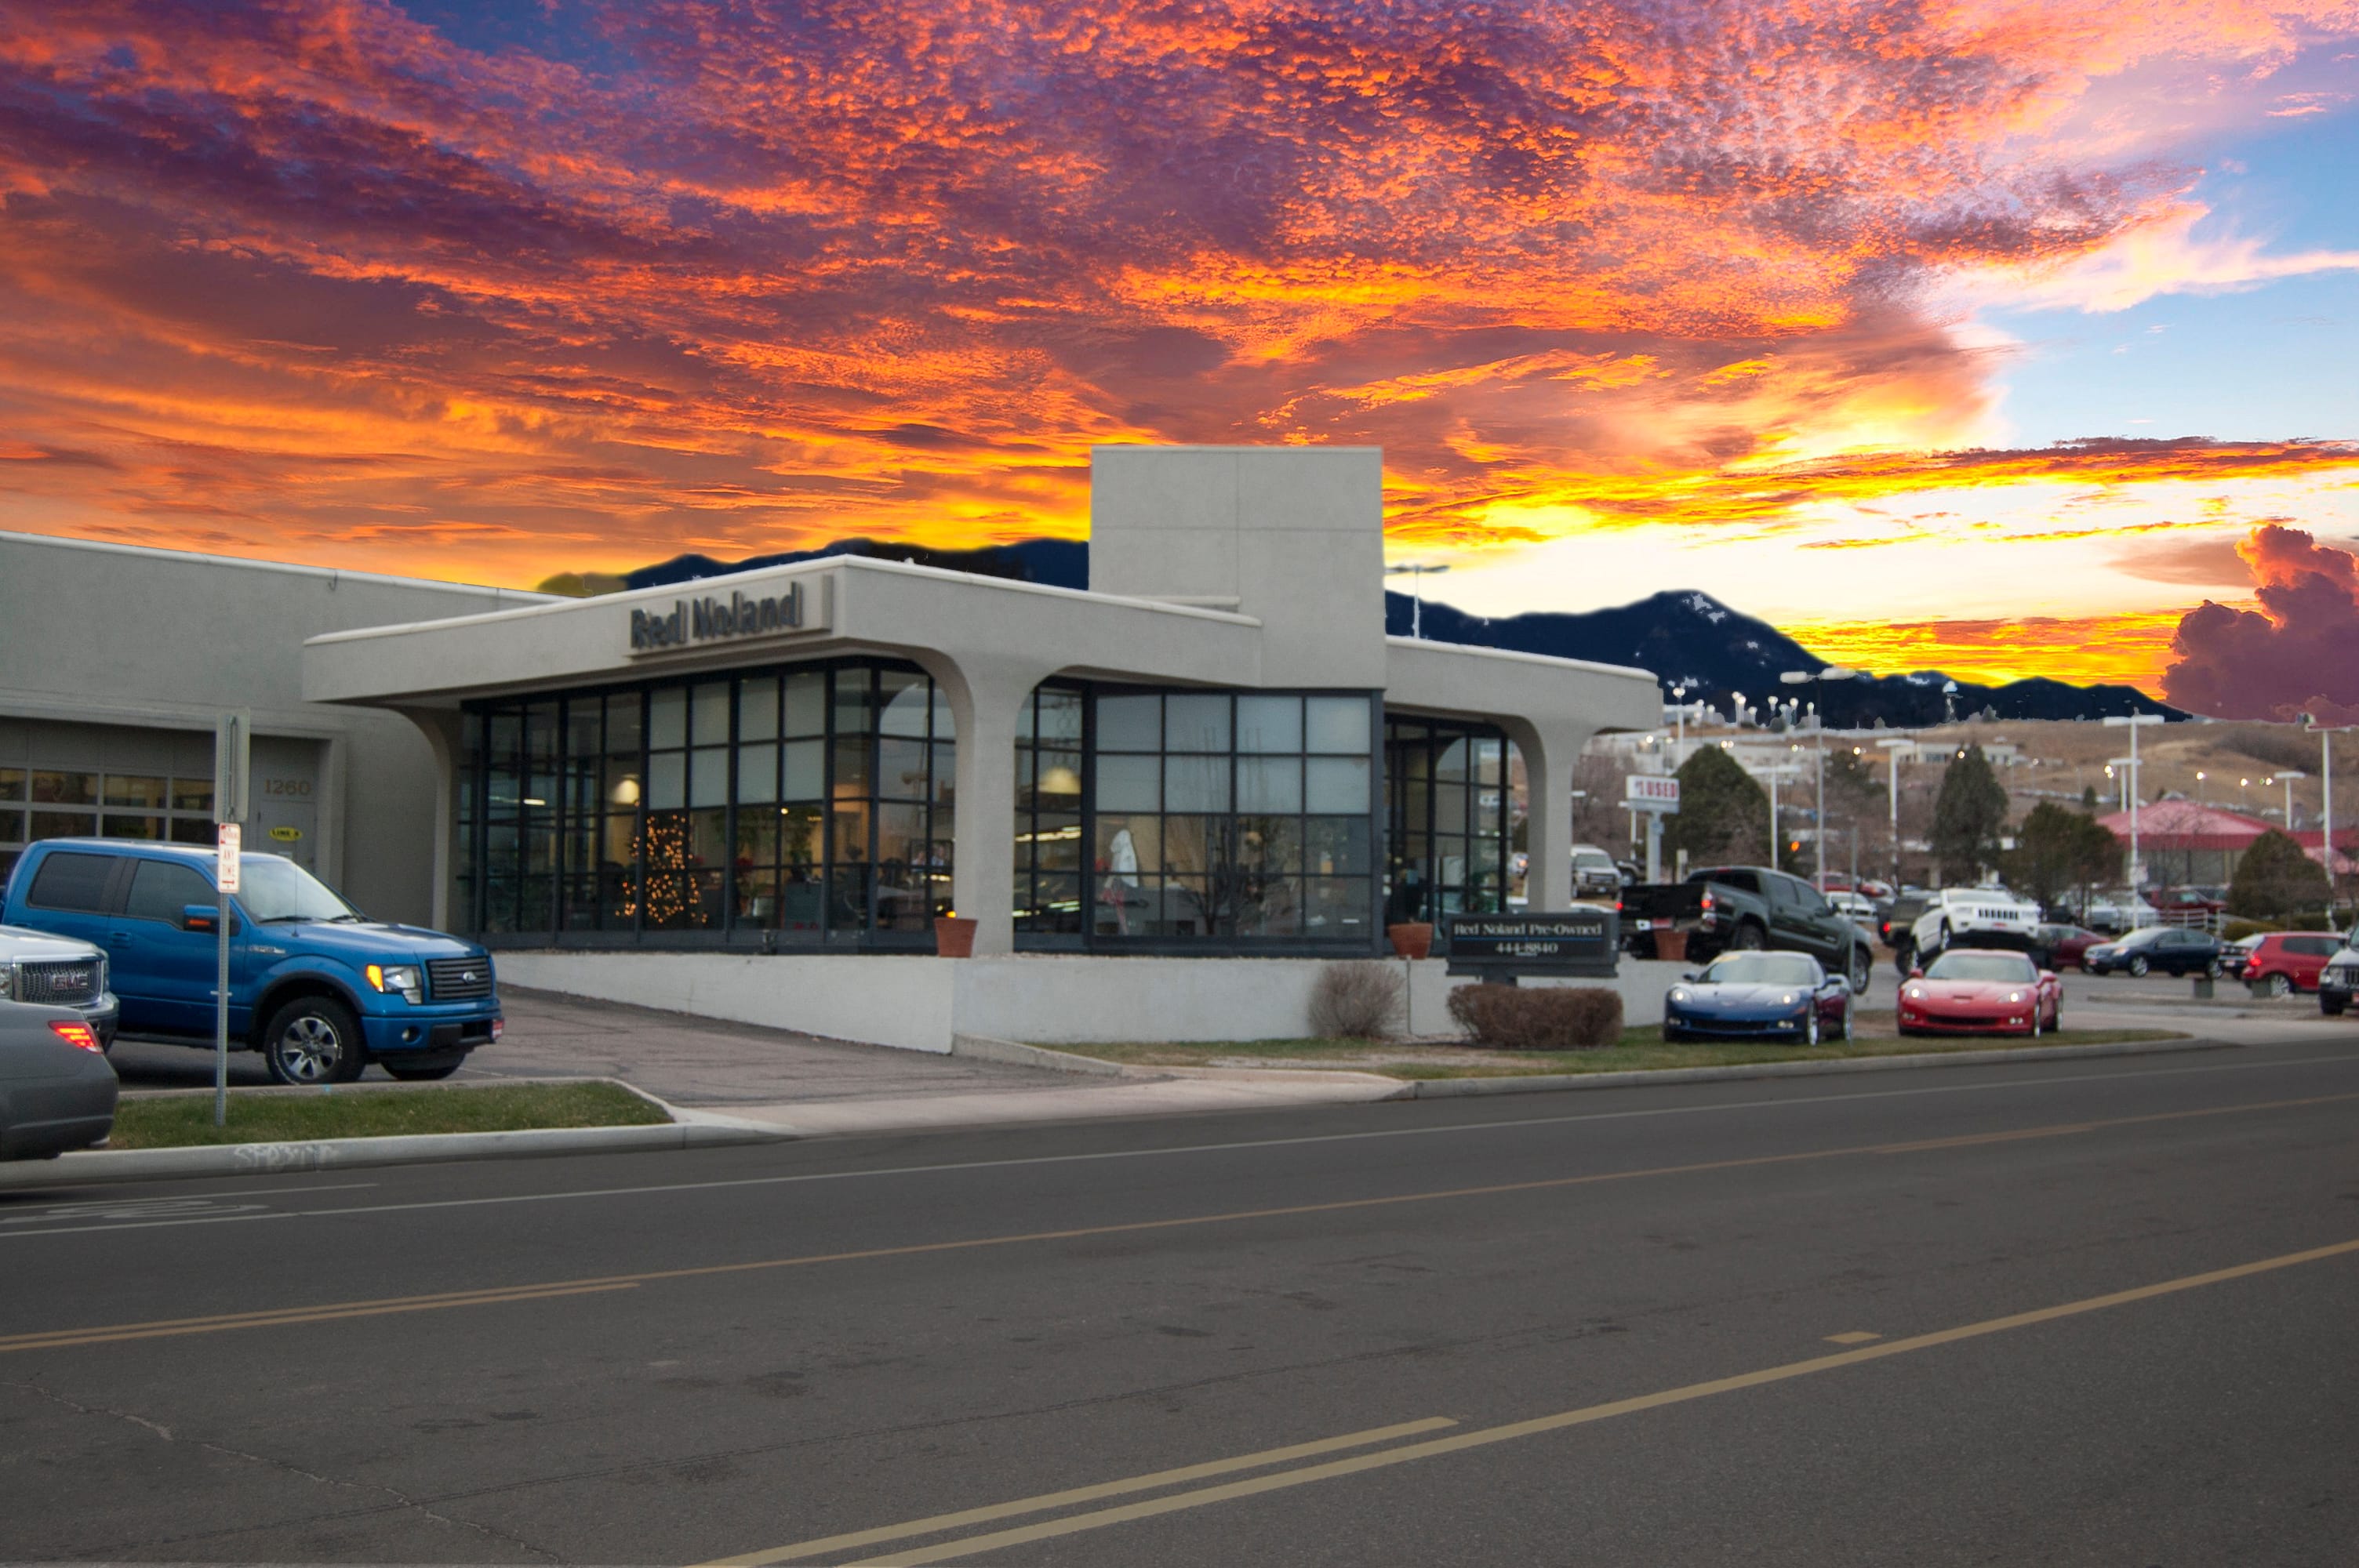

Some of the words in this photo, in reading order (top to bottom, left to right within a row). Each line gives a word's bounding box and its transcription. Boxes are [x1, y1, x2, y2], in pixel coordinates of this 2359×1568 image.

[631, 600, 688, 648] Red
[692, 580, 803, 641] Noland
[264, 779, 311, 796] 1260
[1648, 781, 1677, 797] USED
[1454, 924, 1479, 935] Red
[1483, 924, 1525, 935] Noland
[1530, 924, 1601, 935] Pre-Owned
[53, 972, 89, 991] GMC
